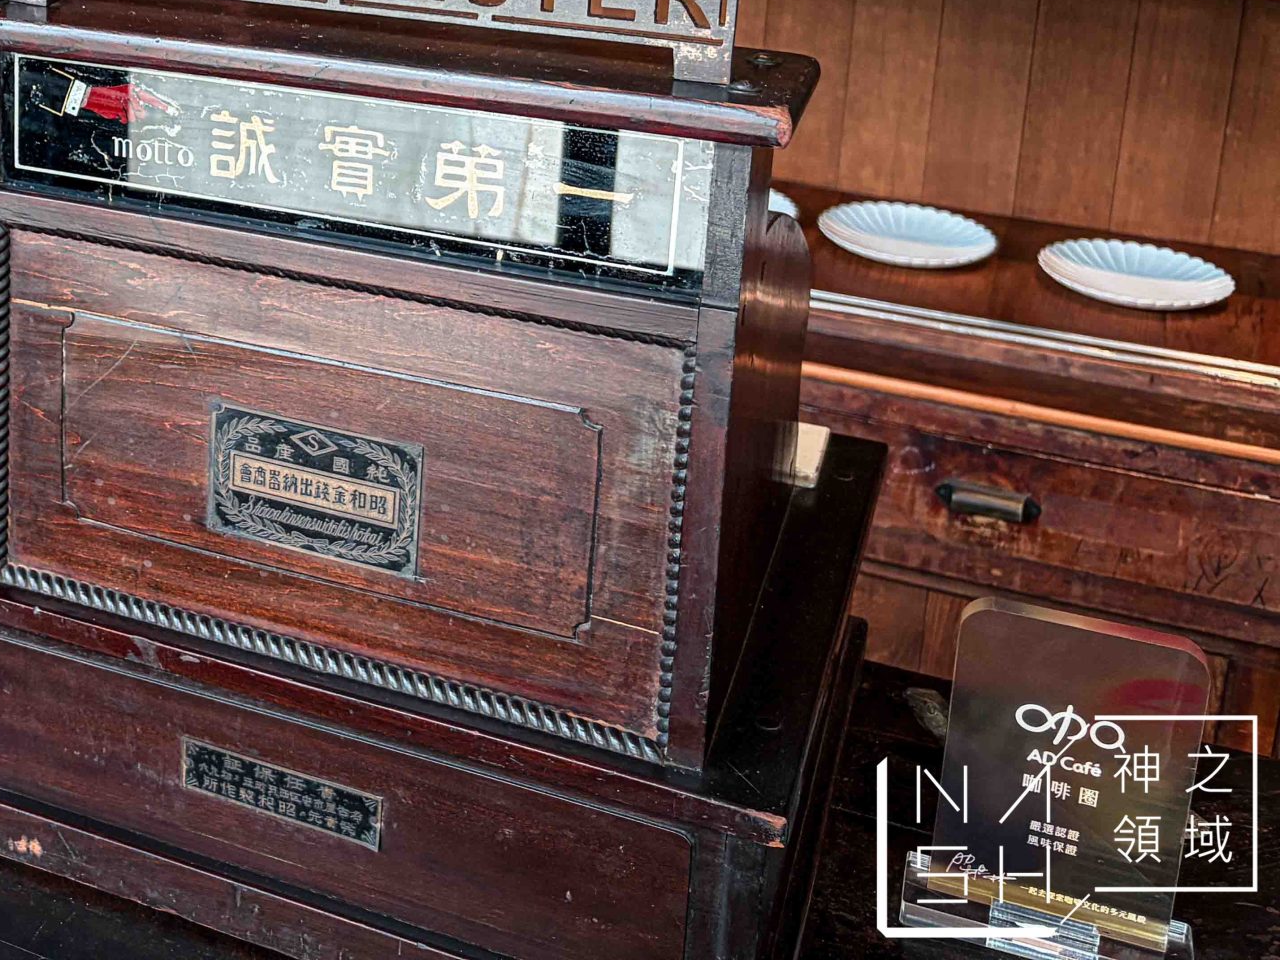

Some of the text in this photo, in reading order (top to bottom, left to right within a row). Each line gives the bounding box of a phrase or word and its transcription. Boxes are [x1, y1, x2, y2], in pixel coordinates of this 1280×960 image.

[112, 135, 194, 168] motto
[210, 112, 634, 219] 誠實第一
[1026, 748, 1102, 777] AD Café
